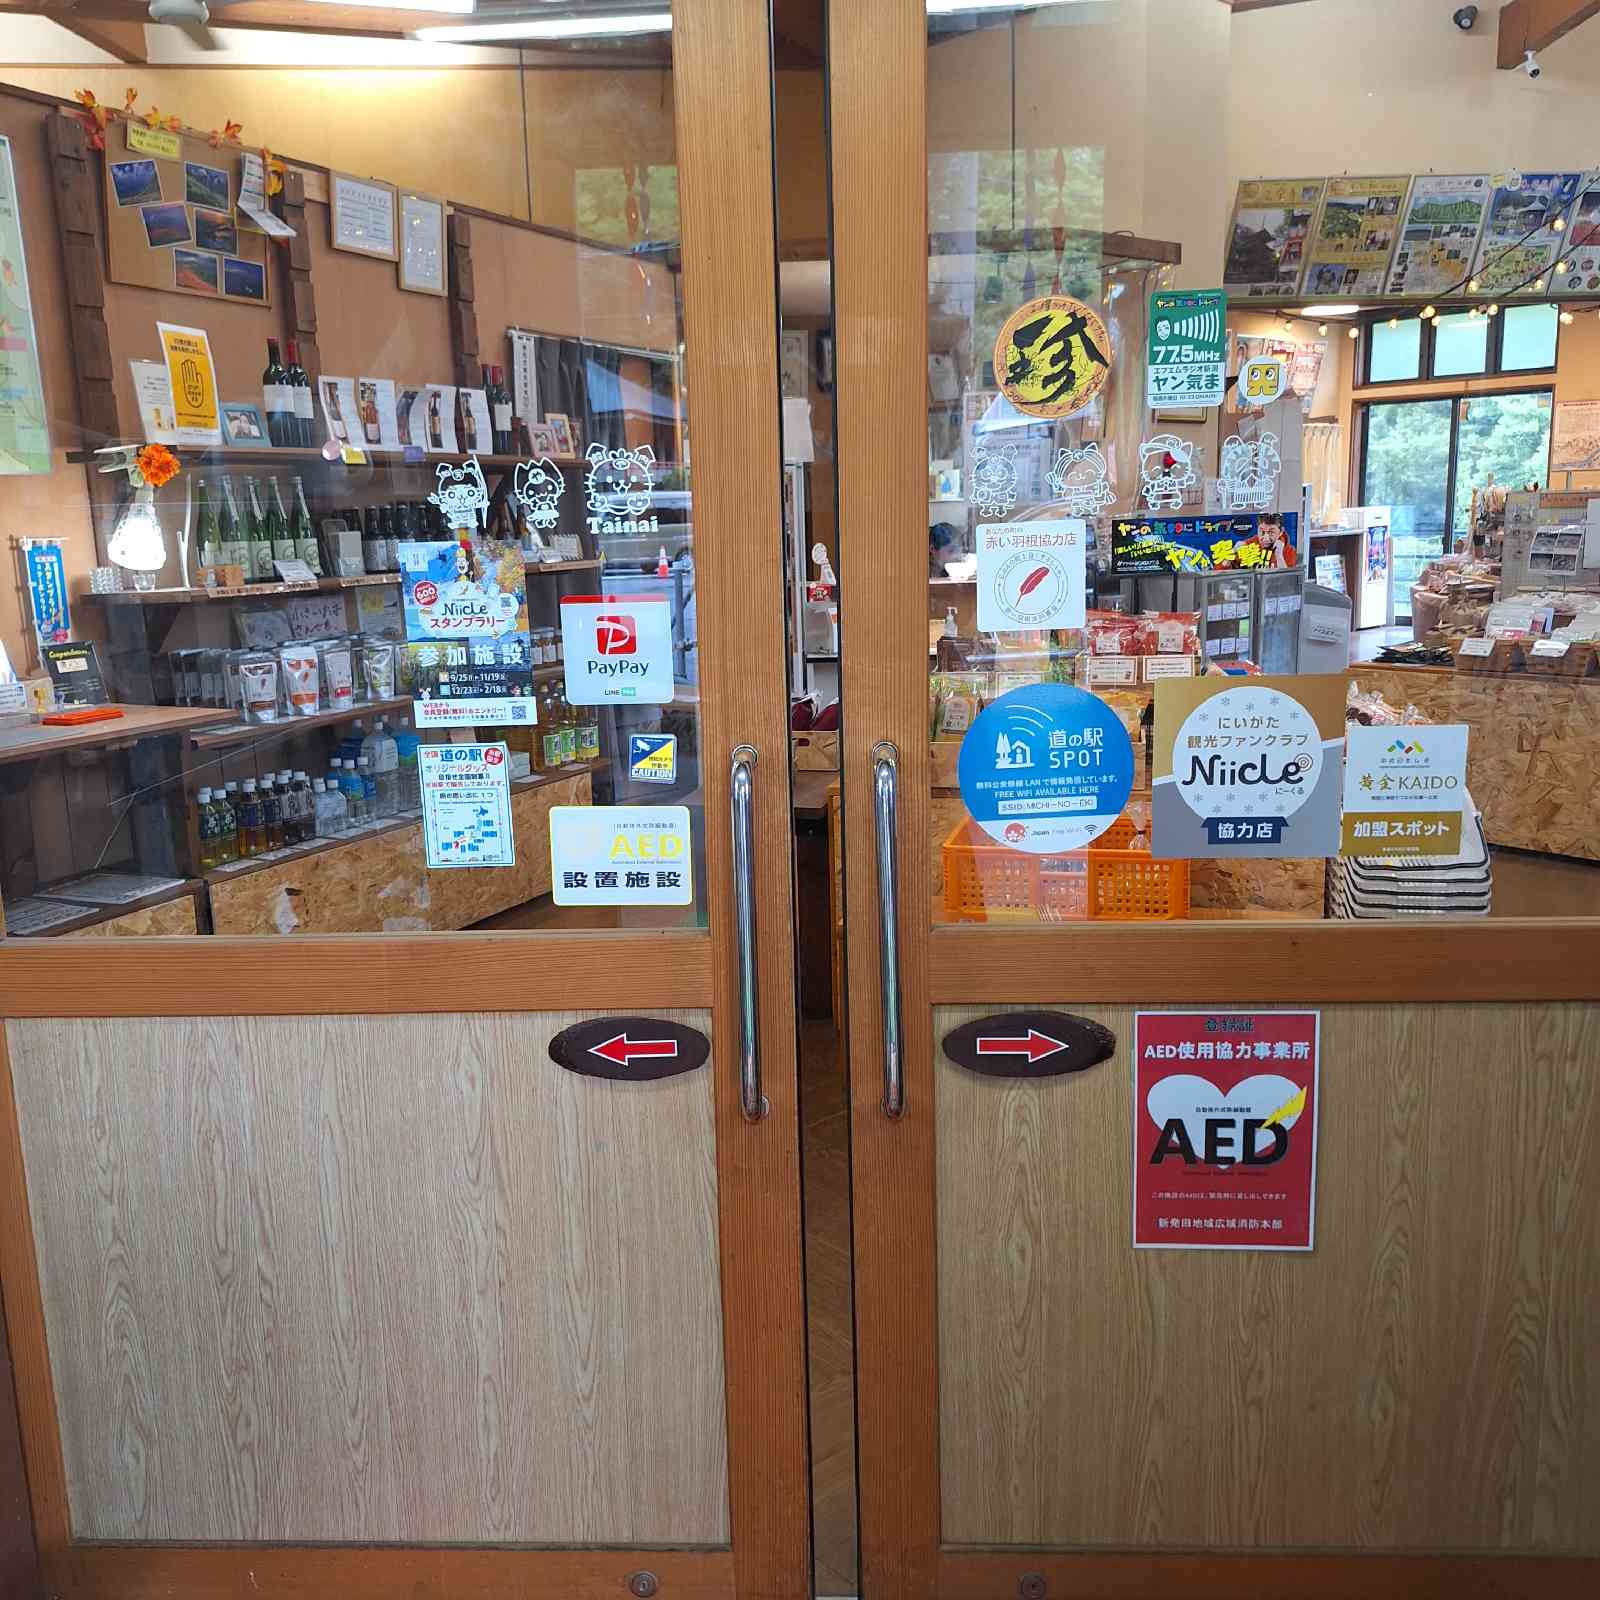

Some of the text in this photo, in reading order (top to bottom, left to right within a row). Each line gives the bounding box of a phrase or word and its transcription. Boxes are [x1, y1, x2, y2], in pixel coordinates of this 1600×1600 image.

[1152, 374, 1220, 392] ヤン気ま
[586, 516, 659, 535] Tainai
[985, 533, 1077, 551] 赤い羽根協力店
[430, 617, 505, 629] スタンプラリー
[417, 644, 524, 668] 参加施設
[586, 658, 650, 679] PayPay
[604, 688, 621, 697] LINE
[1217, 715, 1280, 729] にいがた
[1048, 727, 1104, 749] 道の駅
[1187, 733, 1311, 749] 観光ファンクラブ
[440, 749, 482, 762] 道の駅
[1049, 749, 1104, 769] SPOT
[631, 768, 673, 779] CAUTION
[1181, 752, 1306, 787] Niicle
[1079, 785, 1101, 794] HERE
[1274, 787, 1304, 797] にーくる
[1216, 821, 1273, 840] 協力店
[1353, 819, 1450, 838] 加盟スポット
[608, 832, 684, 860] AED
[562, 871, 681, 889] 設置施設
[1144, 1041, 1311, 1061] AED使用協力事業所
[1149, 1117, 1289, 1166] AED
[1157, 1216, 1284, 1231] 新発田地域広域消防本部
